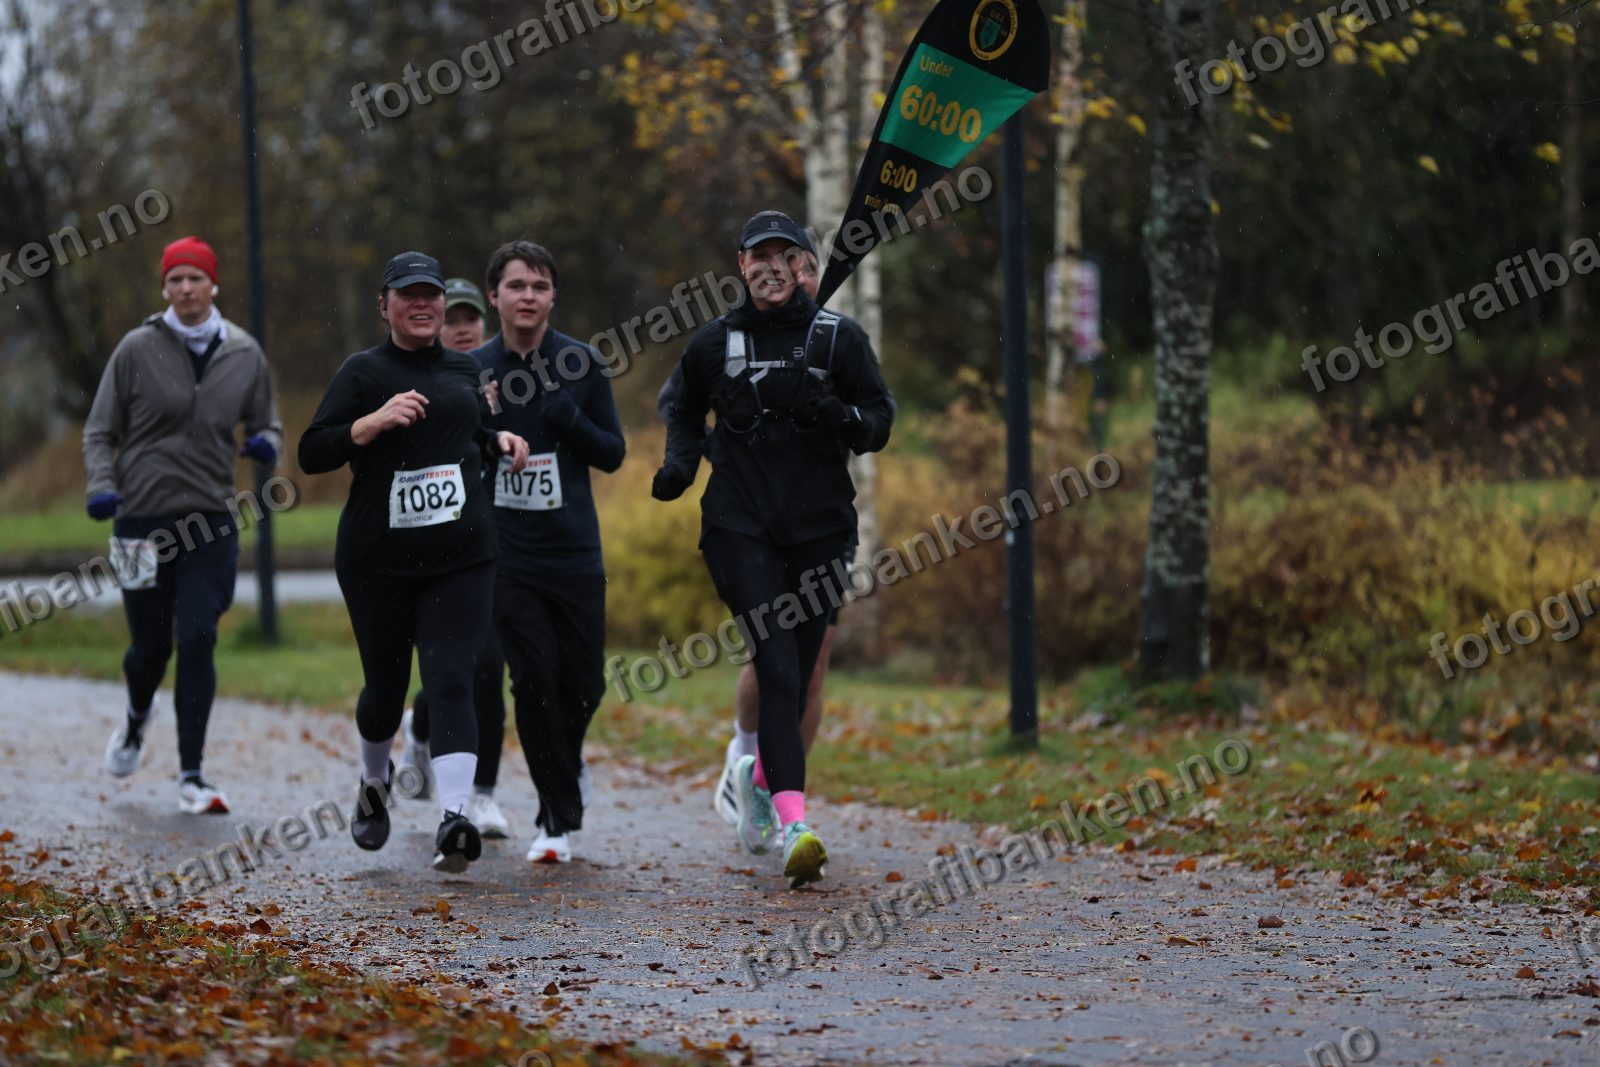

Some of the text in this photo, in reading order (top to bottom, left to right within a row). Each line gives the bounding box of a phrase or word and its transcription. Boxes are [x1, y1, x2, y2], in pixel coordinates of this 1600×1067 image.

[919, 54, 954, 79] Under
[900, 84, 982, 144] 60:00
[880, 159, 918, 193] 6:00
[397, 480, 459, 514] 1082
[501, 469, 553, 496] 1075
